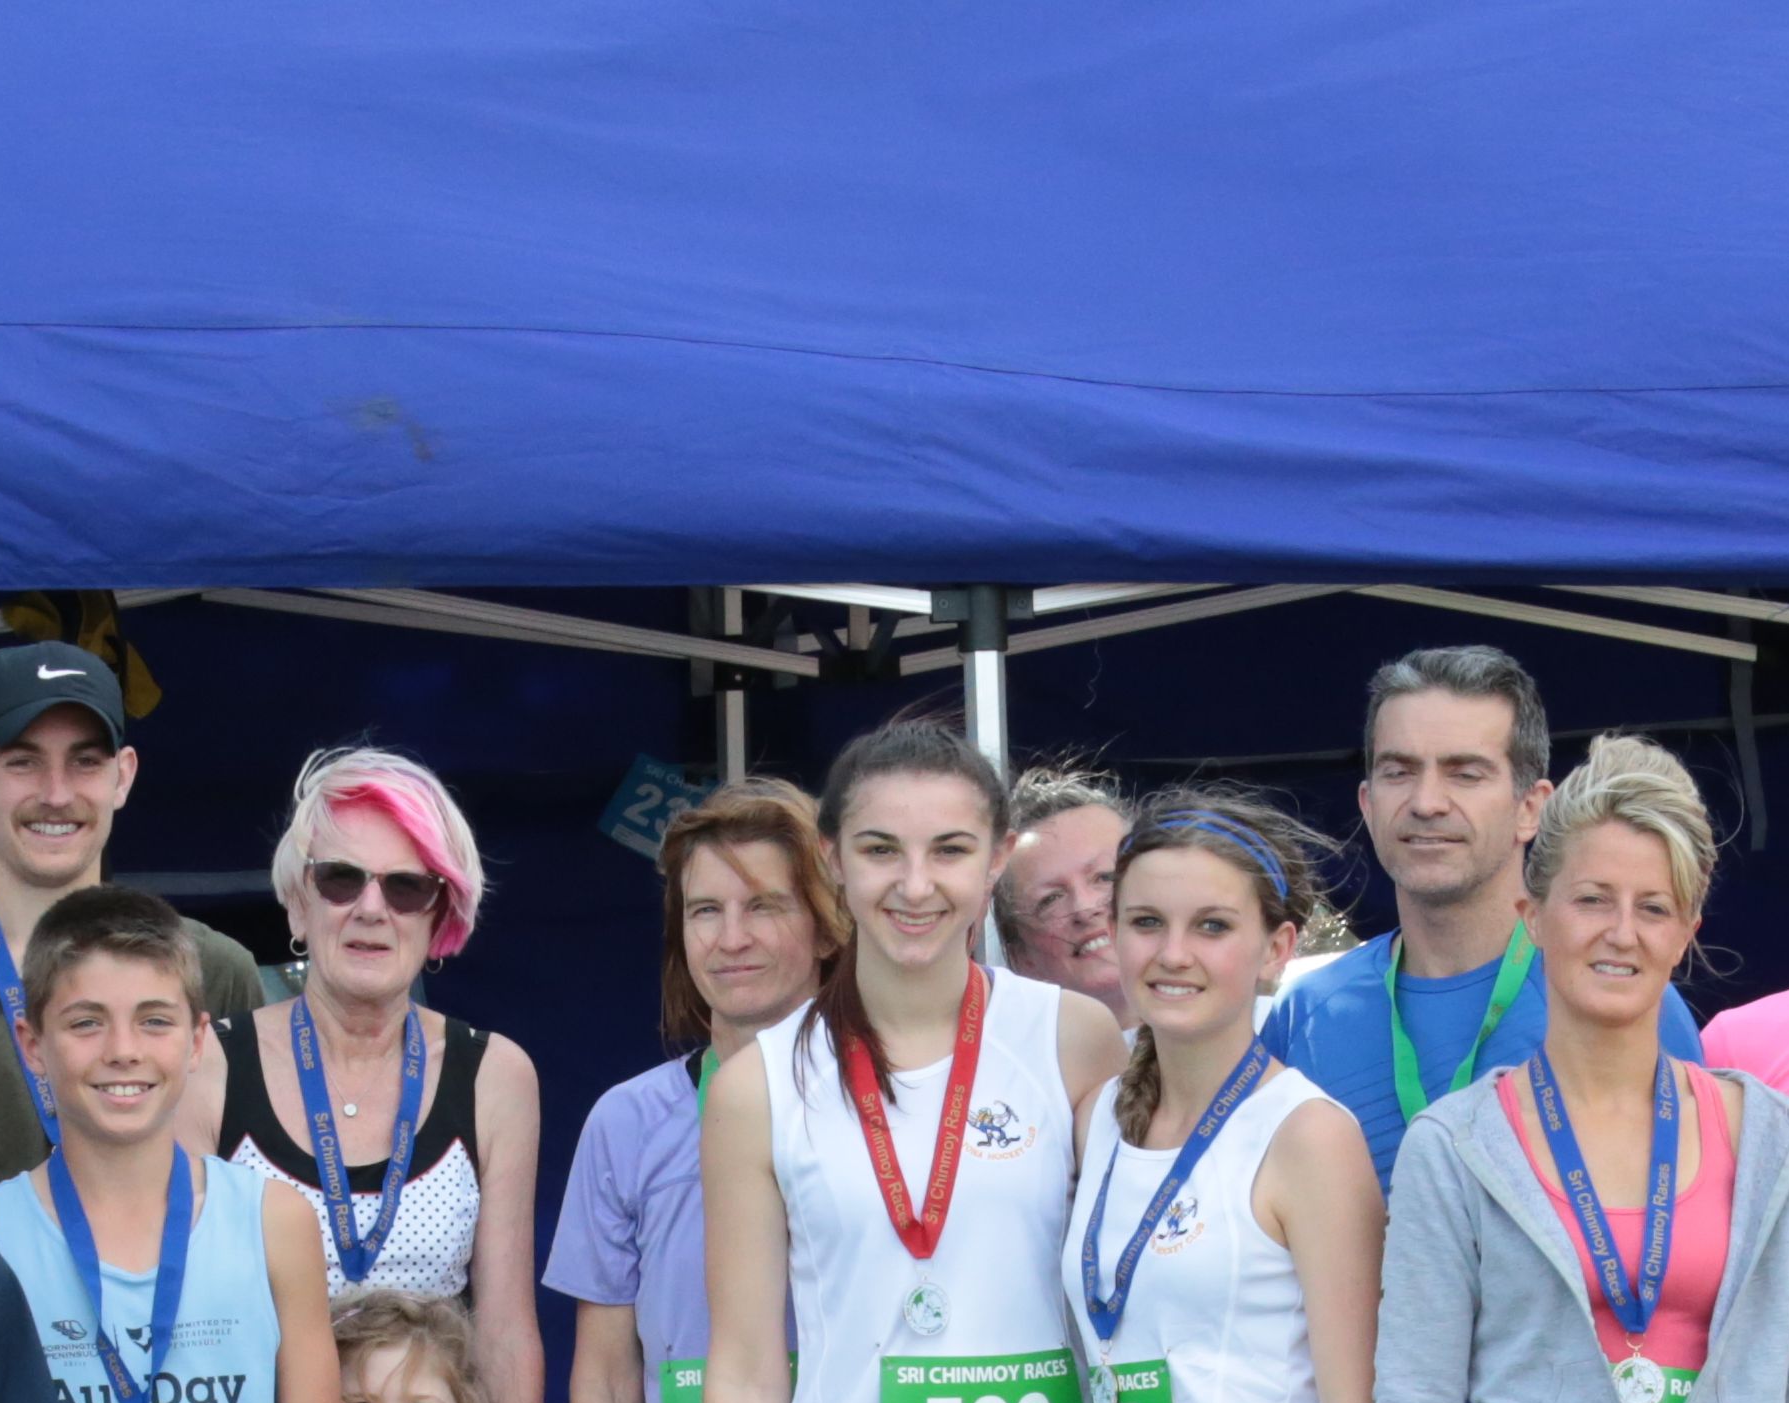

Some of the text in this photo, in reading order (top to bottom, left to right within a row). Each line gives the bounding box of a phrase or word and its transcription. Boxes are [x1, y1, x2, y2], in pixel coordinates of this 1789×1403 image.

[298, 1029, 315, 1071] Races
[1198, 1055, 1261, 1139] Sri Chinmoy
[1540, 1086, 1562, 1132] Races
[925, 1084, 965, 1225] Sri Chinmoy Races
[314, 1111, 353, 1250] Sri Chinmoy Races
[365, 1120, 410, 1251] Sri Chinmoy Races
[888, 1182, 909, 1230] Races
[1568, 1168, 1626, 1306] Sri Chinmoy Races
[1643, 1163, 1670, 1301] Sri Chinmoy Races
[171, 1327, 233, 1340] USTAINABLE
[675, 1369, 702, 1388] SRI
[897, 1358, 1069, 1385] SRI CHINMOY RACES
[1117, 1370, 1160, 1392] RACES
